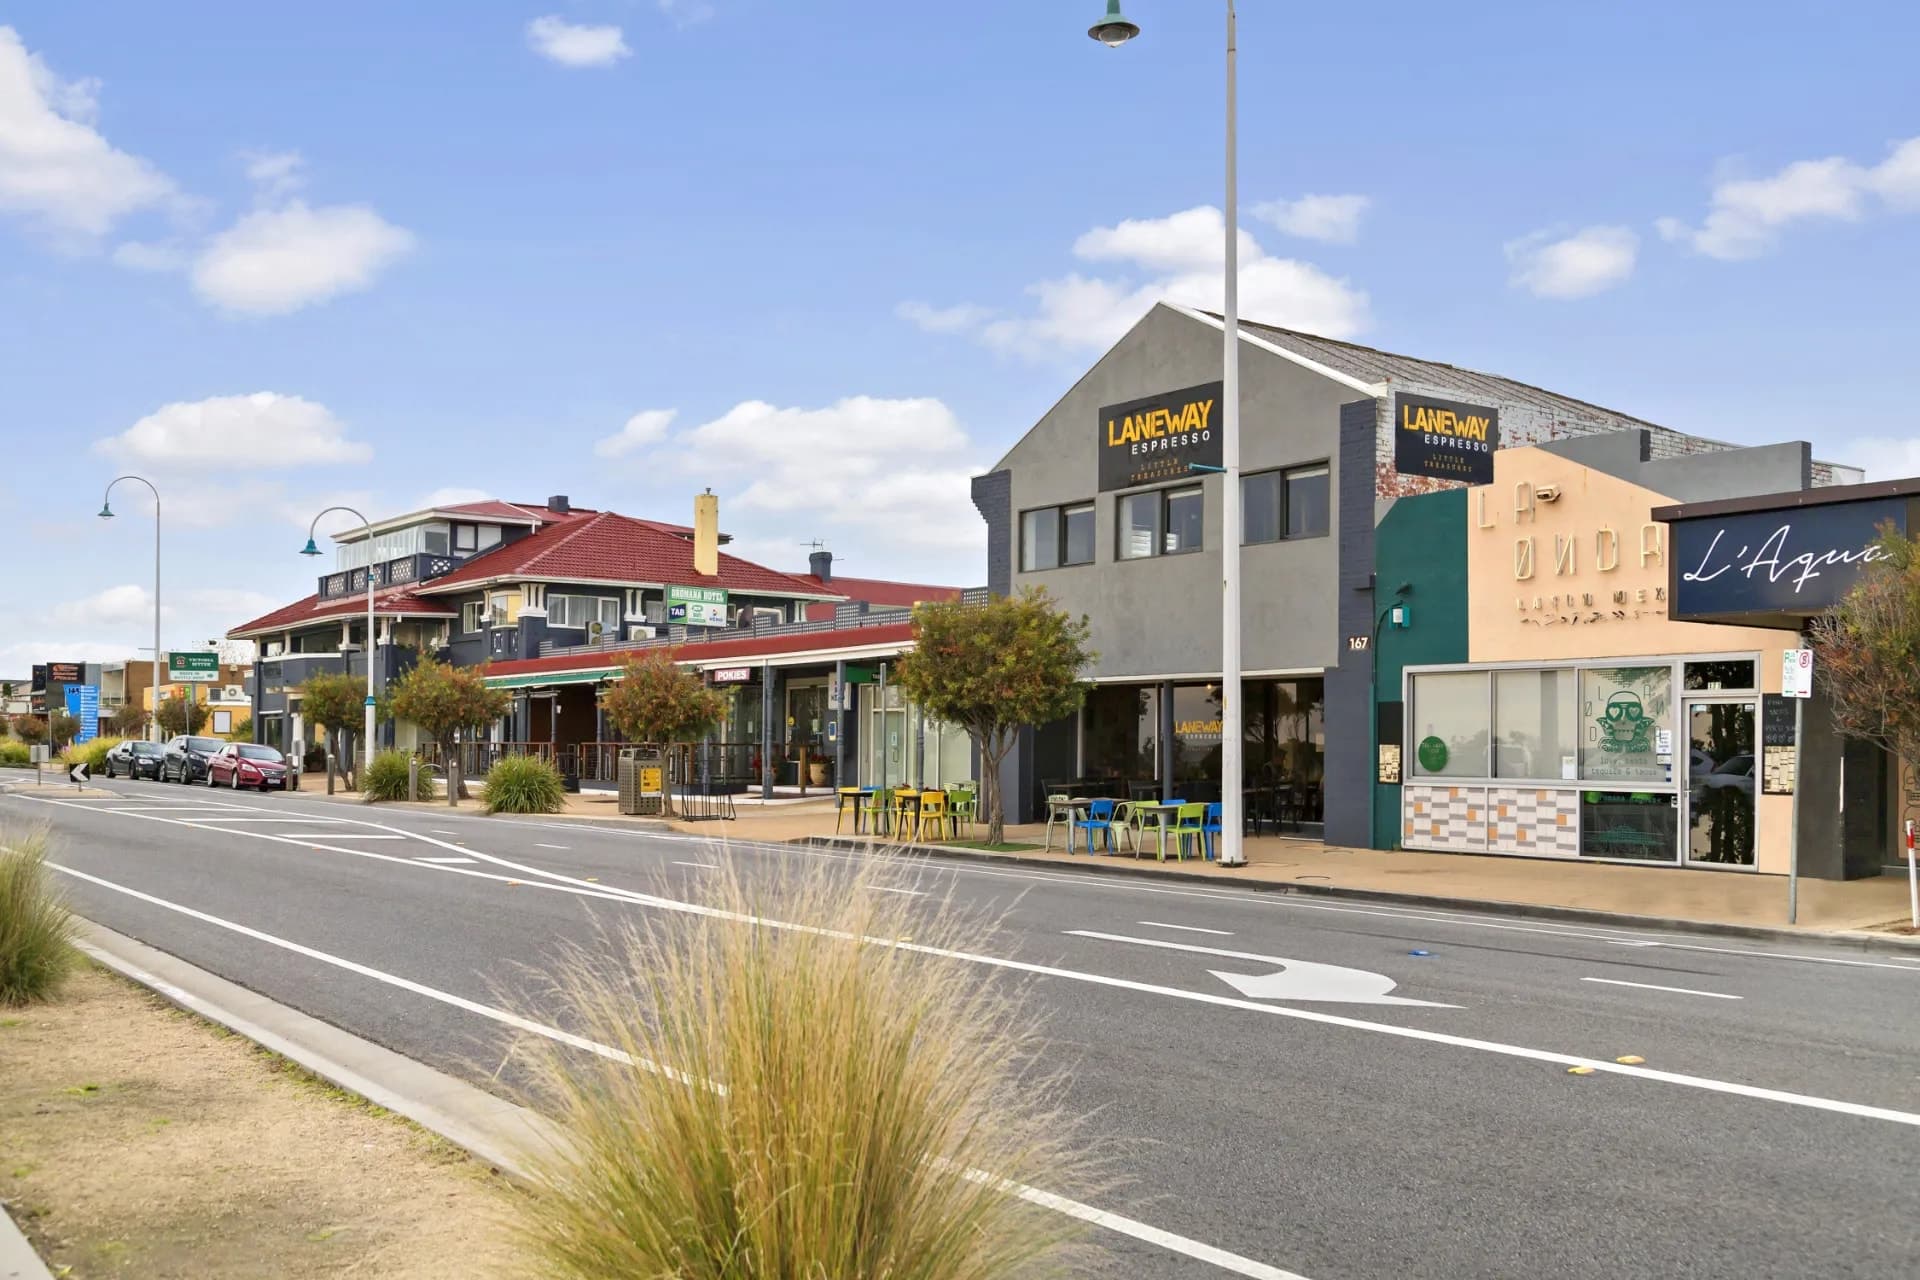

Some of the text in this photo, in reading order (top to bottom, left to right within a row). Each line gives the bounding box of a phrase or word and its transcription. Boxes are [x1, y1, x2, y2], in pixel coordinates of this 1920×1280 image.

[1108, 400, 1213, 447] LANEWAY
[1403, 405, 1490, 441] LANEWAY
[1131, 431, 1210, 454] ESPRESSO
[1424, 434, 1488, 452] ESPRESSO
[704, 591, 725, 602] HOTEL
[671, 608, 685, 616] TAB
[1349, 637, 1368, 649] 167
[718, 670, 747, 680] POKIES
[1175, 720, 1223, 733] LANEWAY
